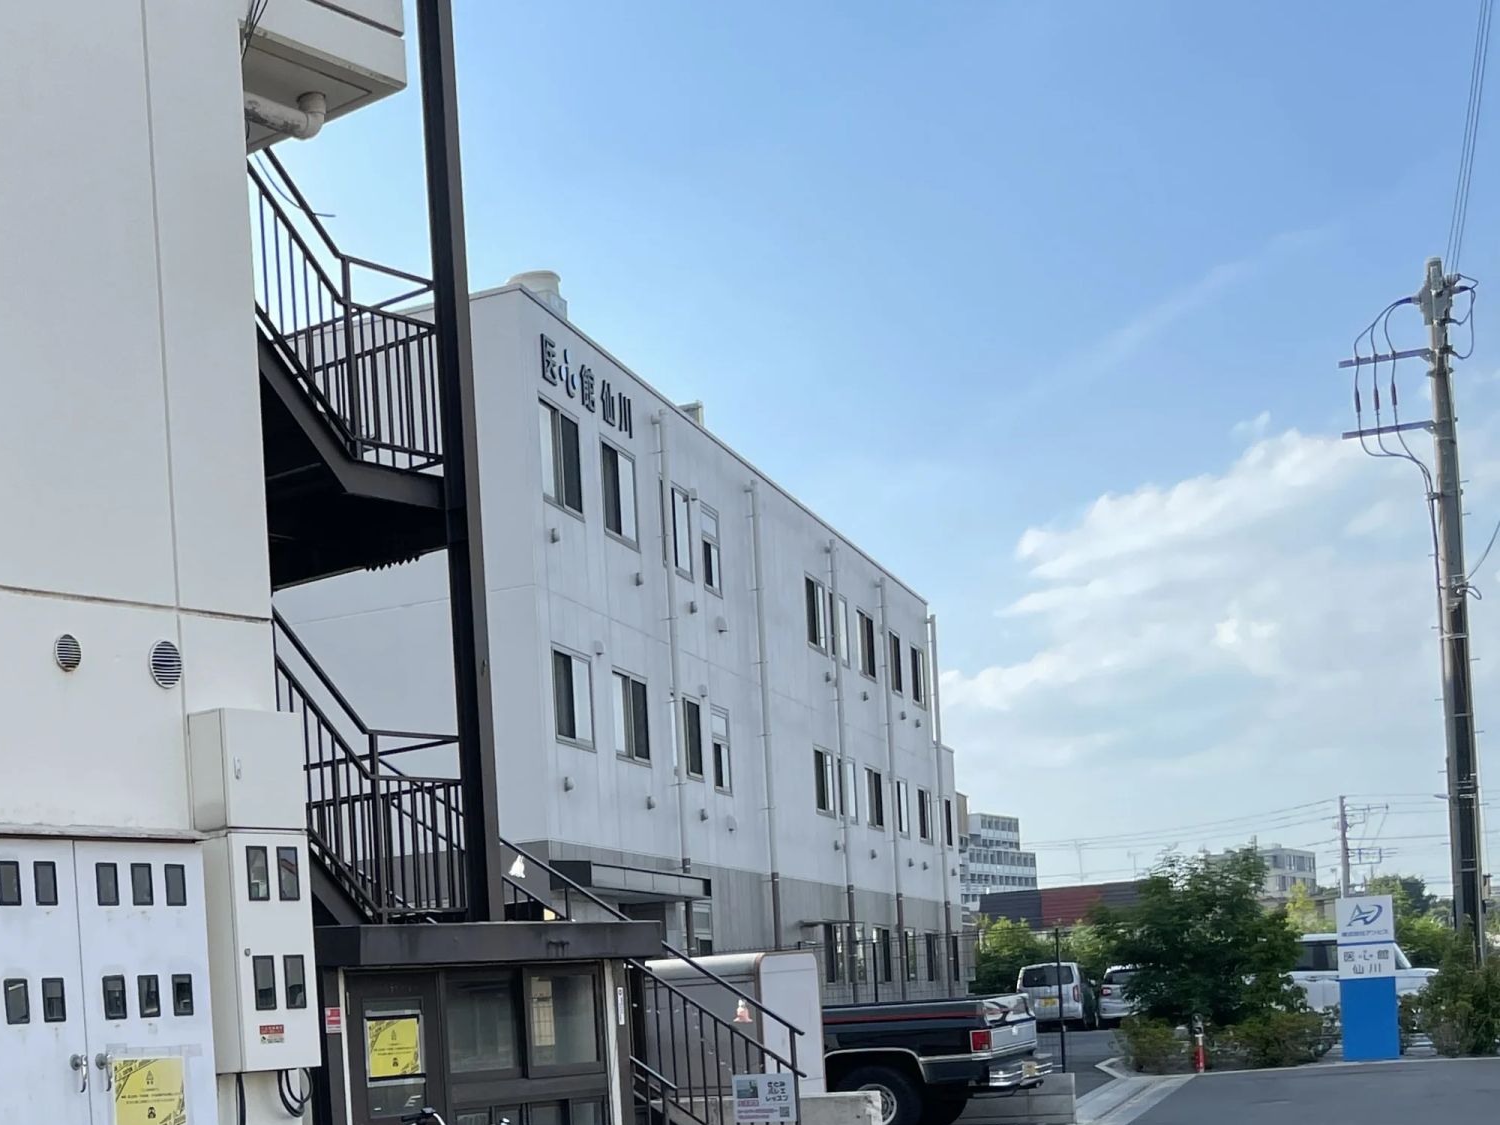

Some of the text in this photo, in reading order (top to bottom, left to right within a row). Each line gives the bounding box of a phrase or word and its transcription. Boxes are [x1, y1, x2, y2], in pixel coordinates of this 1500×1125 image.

[1343, 949, 1389, 962] 医心館
[1352, 963, 1381, 975] 仙川
